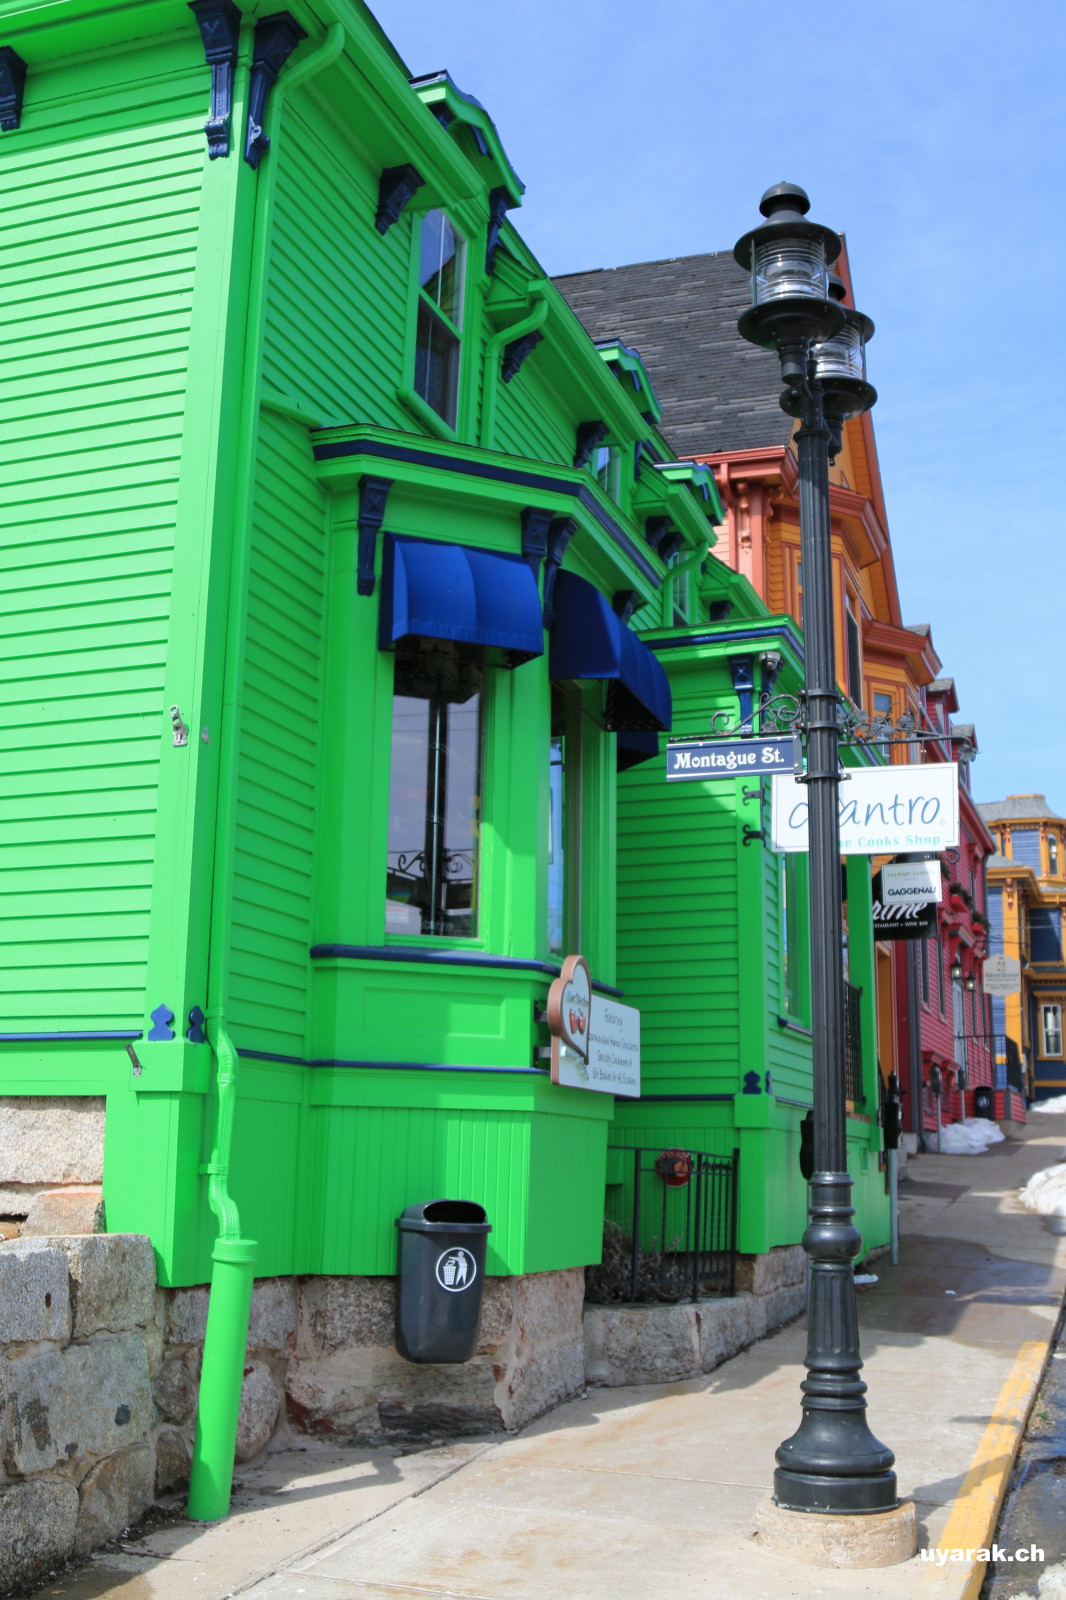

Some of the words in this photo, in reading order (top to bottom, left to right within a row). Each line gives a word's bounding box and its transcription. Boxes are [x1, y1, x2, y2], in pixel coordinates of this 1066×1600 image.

[674, 751, 757, 770] Montague
[761, 746, 785, 763] St.
[788, 794, 940, 829] cantro
[858, 835, 900, 848] Cooks
[906, 834, 940, 847] Shop
[887, 886, 936, 896] GAGGENAU
